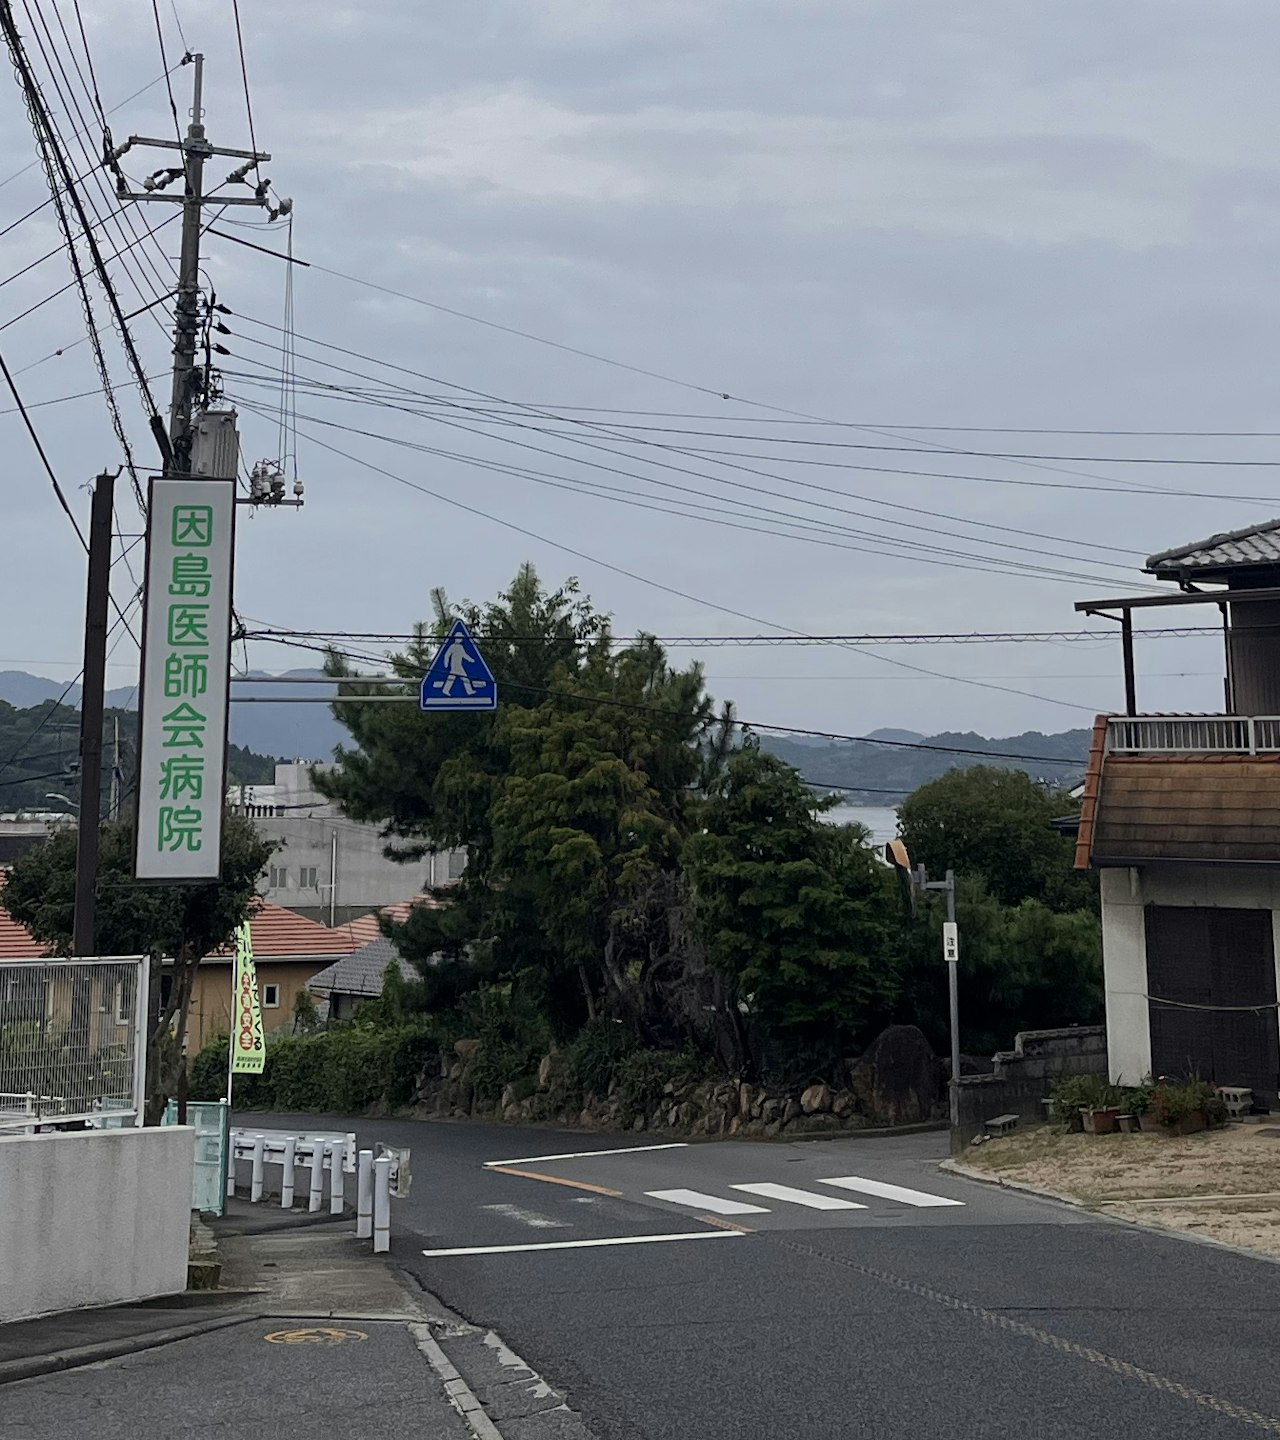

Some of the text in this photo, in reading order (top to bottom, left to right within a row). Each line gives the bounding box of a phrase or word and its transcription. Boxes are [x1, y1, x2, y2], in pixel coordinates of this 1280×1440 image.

[157, 505, 213, 852] 因島医師会病院
